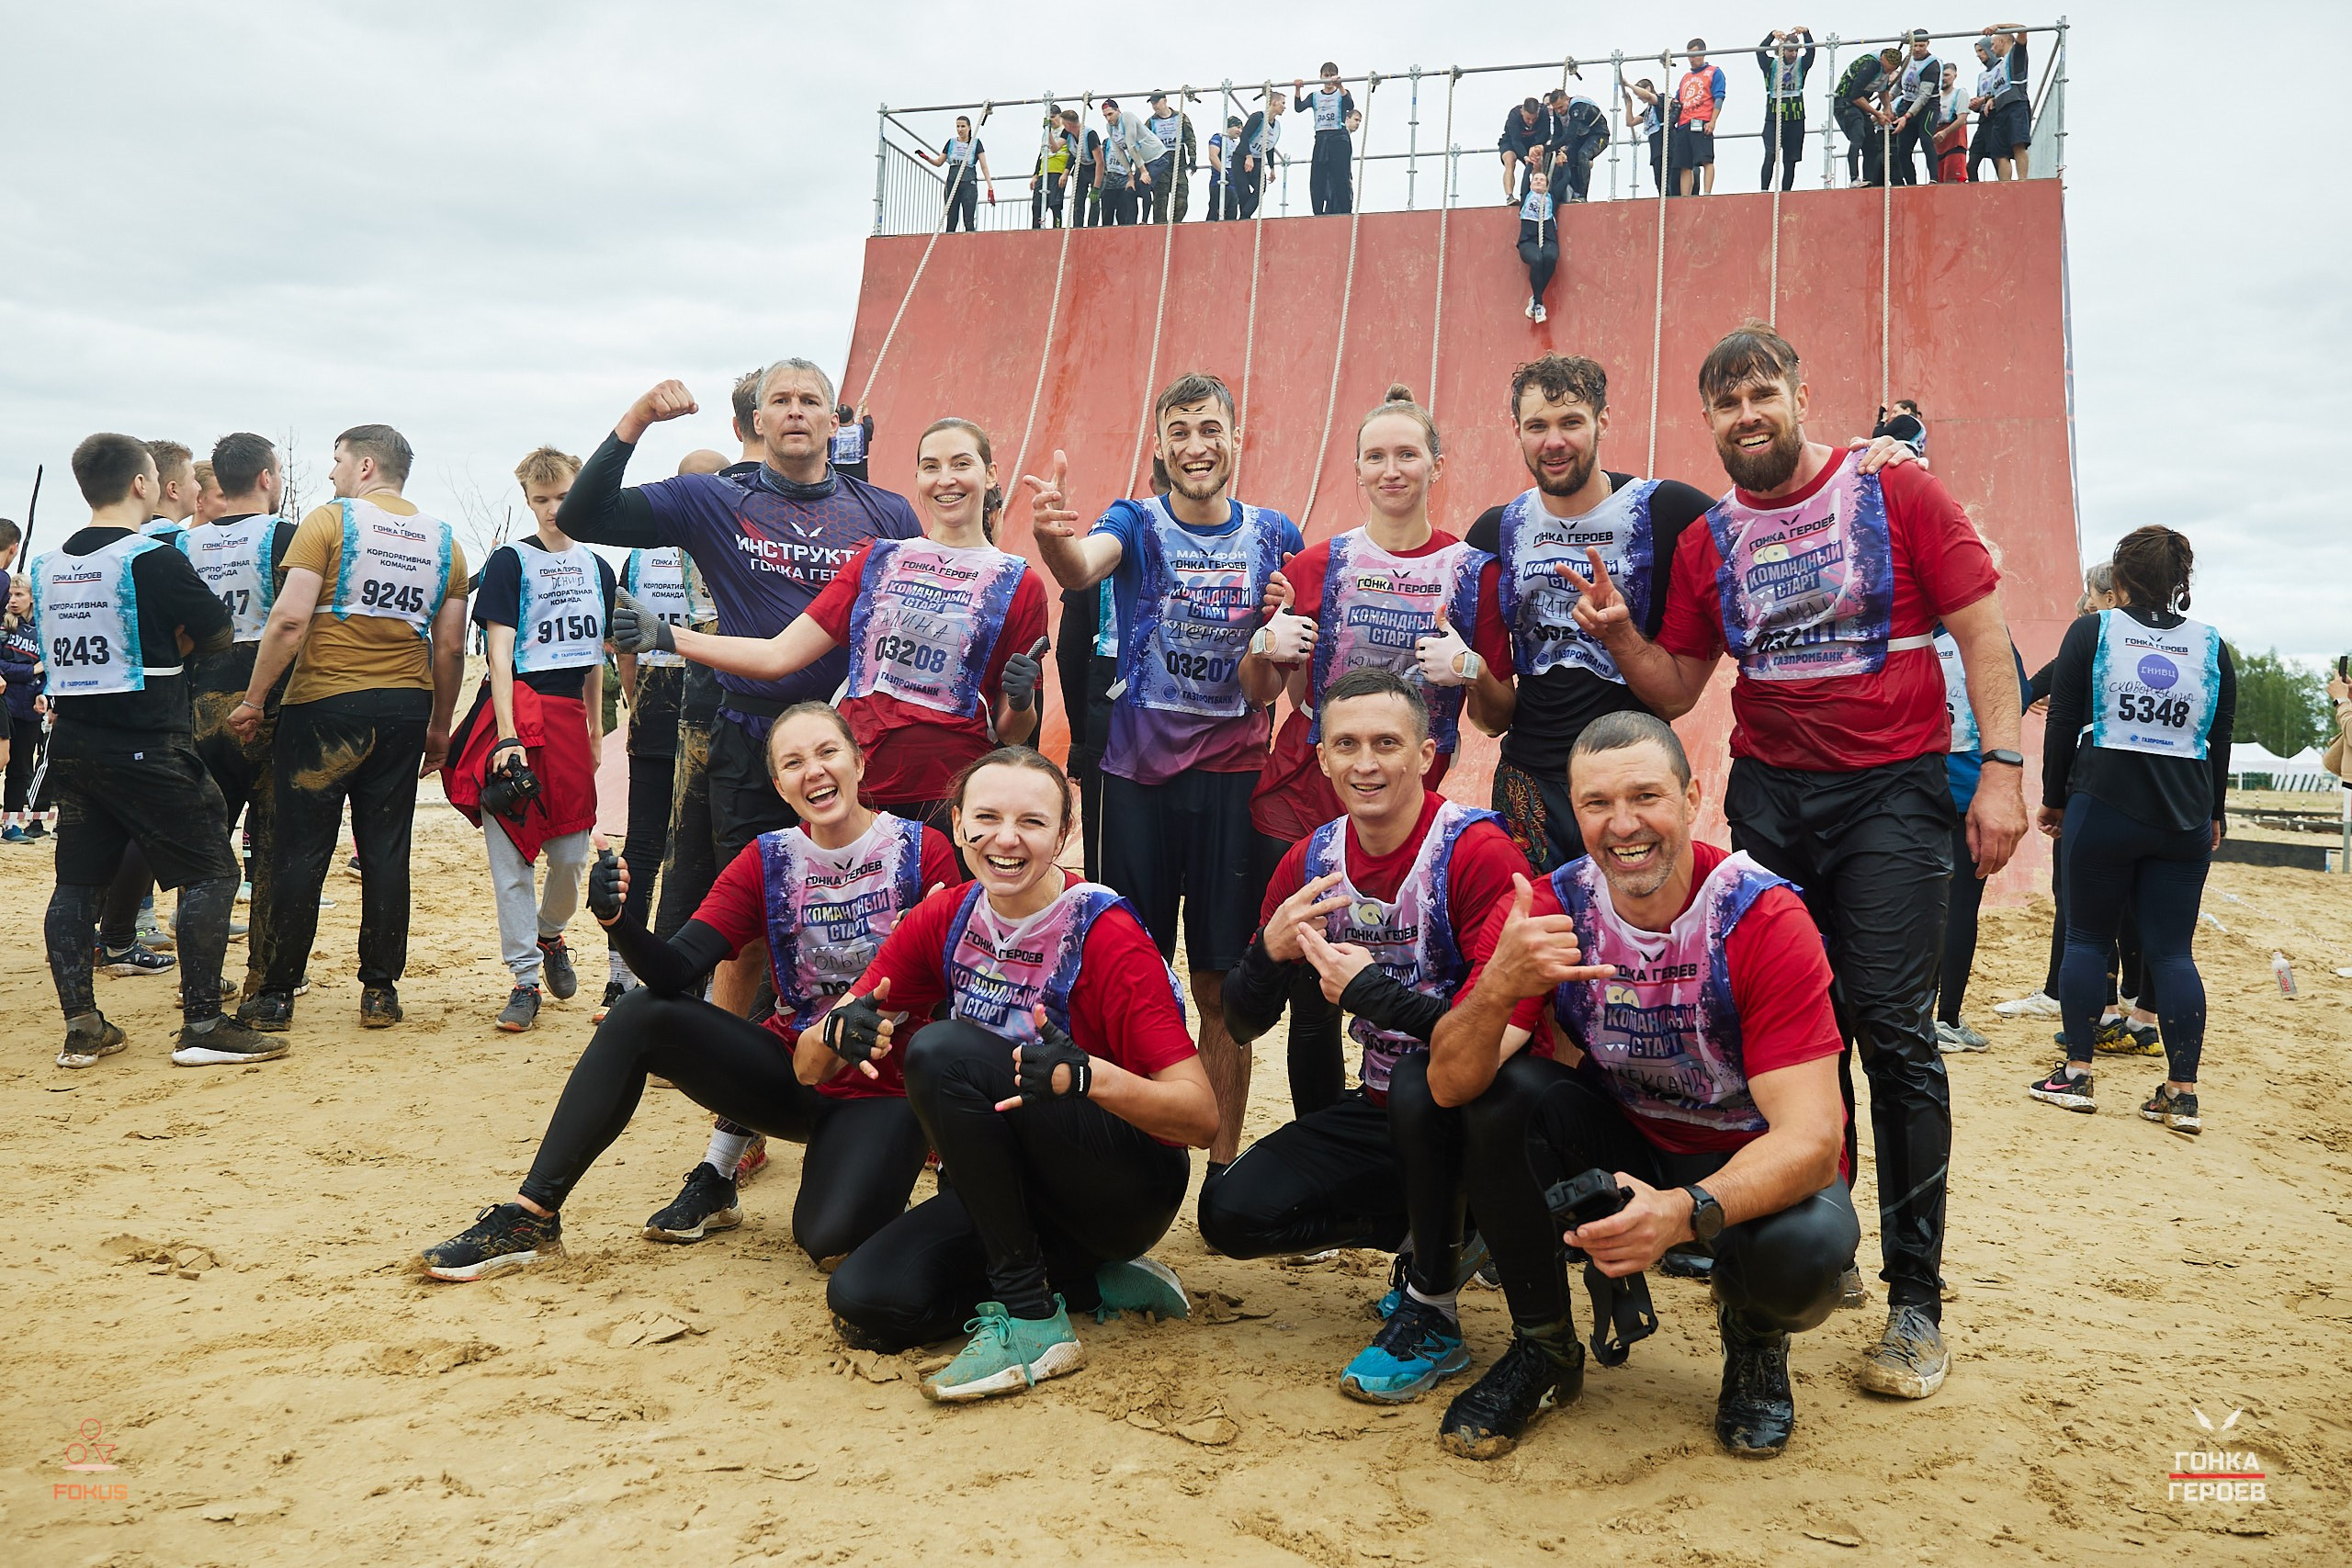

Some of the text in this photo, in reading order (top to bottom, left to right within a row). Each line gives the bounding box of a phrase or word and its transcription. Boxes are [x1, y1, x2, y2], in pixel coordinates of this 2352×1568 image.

[373, 525, 425, 539] ГОНКА ГЕРОЕВ
[1567, 531, 1613, 543] ГЕРОЕВ
[1749, 513, 1835, 552] ГОНКА ГЕРОЕВ
[367, 547, 431, 566] КОРПОРАТИВНАЯ
[735, 534, 860, 565] ИНСТРУКТ
[380, 559, 416, 571] КОМАНДА
[902, 560, 935, 573] ГОНКА
[1170, 559, 1247, 570] ГОНКА ГЕРОЕВ
[1747, 541, 1841, 589] КОМАНДНЫЙ
[74, 571, 101, 580] ГЕРОЕВ
[1357, 579, 1442, 593] ГОНКА ГЕРОЕВ
[1776, 571, 1817, 598] СТАРТ
[361, 579, 424, 613] 9245
[887, 581, 972, 604] КОМАНДНЫЙ
[904, 598, 944, 612] СТАРТ
[1192, 603, 1227, 619] СТАРТ
[537, 615, 597, 644] 9150
[1350, 608, 1438, 631] КОМАНДНЫЙ
[1372, 629, 1414, 647] СТАРТ
[2125, 637, 2188, 653] ГОНКА ГЕРОЕВ
[53, 636, 110, 667] 9243
[875, 635, 947, 674] 03208
[1773, 652, 1843, 665] ГАЗПРОМБАНК
[1166, 650, 1236, 682] 03207
[2141, 666, 2176, 678] ГНИВЦ
[880, 671, 940, 696] ГАЗПРОМБАНК
[2119, 694, 2189, 728] 5348
[806, 861, 882, 885] ГОНКА ГЕРОЕВ
[803, 887, 888, 924] КОМАНДНЫЙ
[830, 919, 865, 940] СТАРТ
[1345, 927, 1381, 942] ГОНКА
[999, 949, 1043, 963] ГЕРОЕВ
[965, 998, 1005, 1023] СТАРТ
[1607, 1005, 1697, 1032] КОМАНДНЫЙ
[1632, 1034, 1679, 1055] СТАРТ
